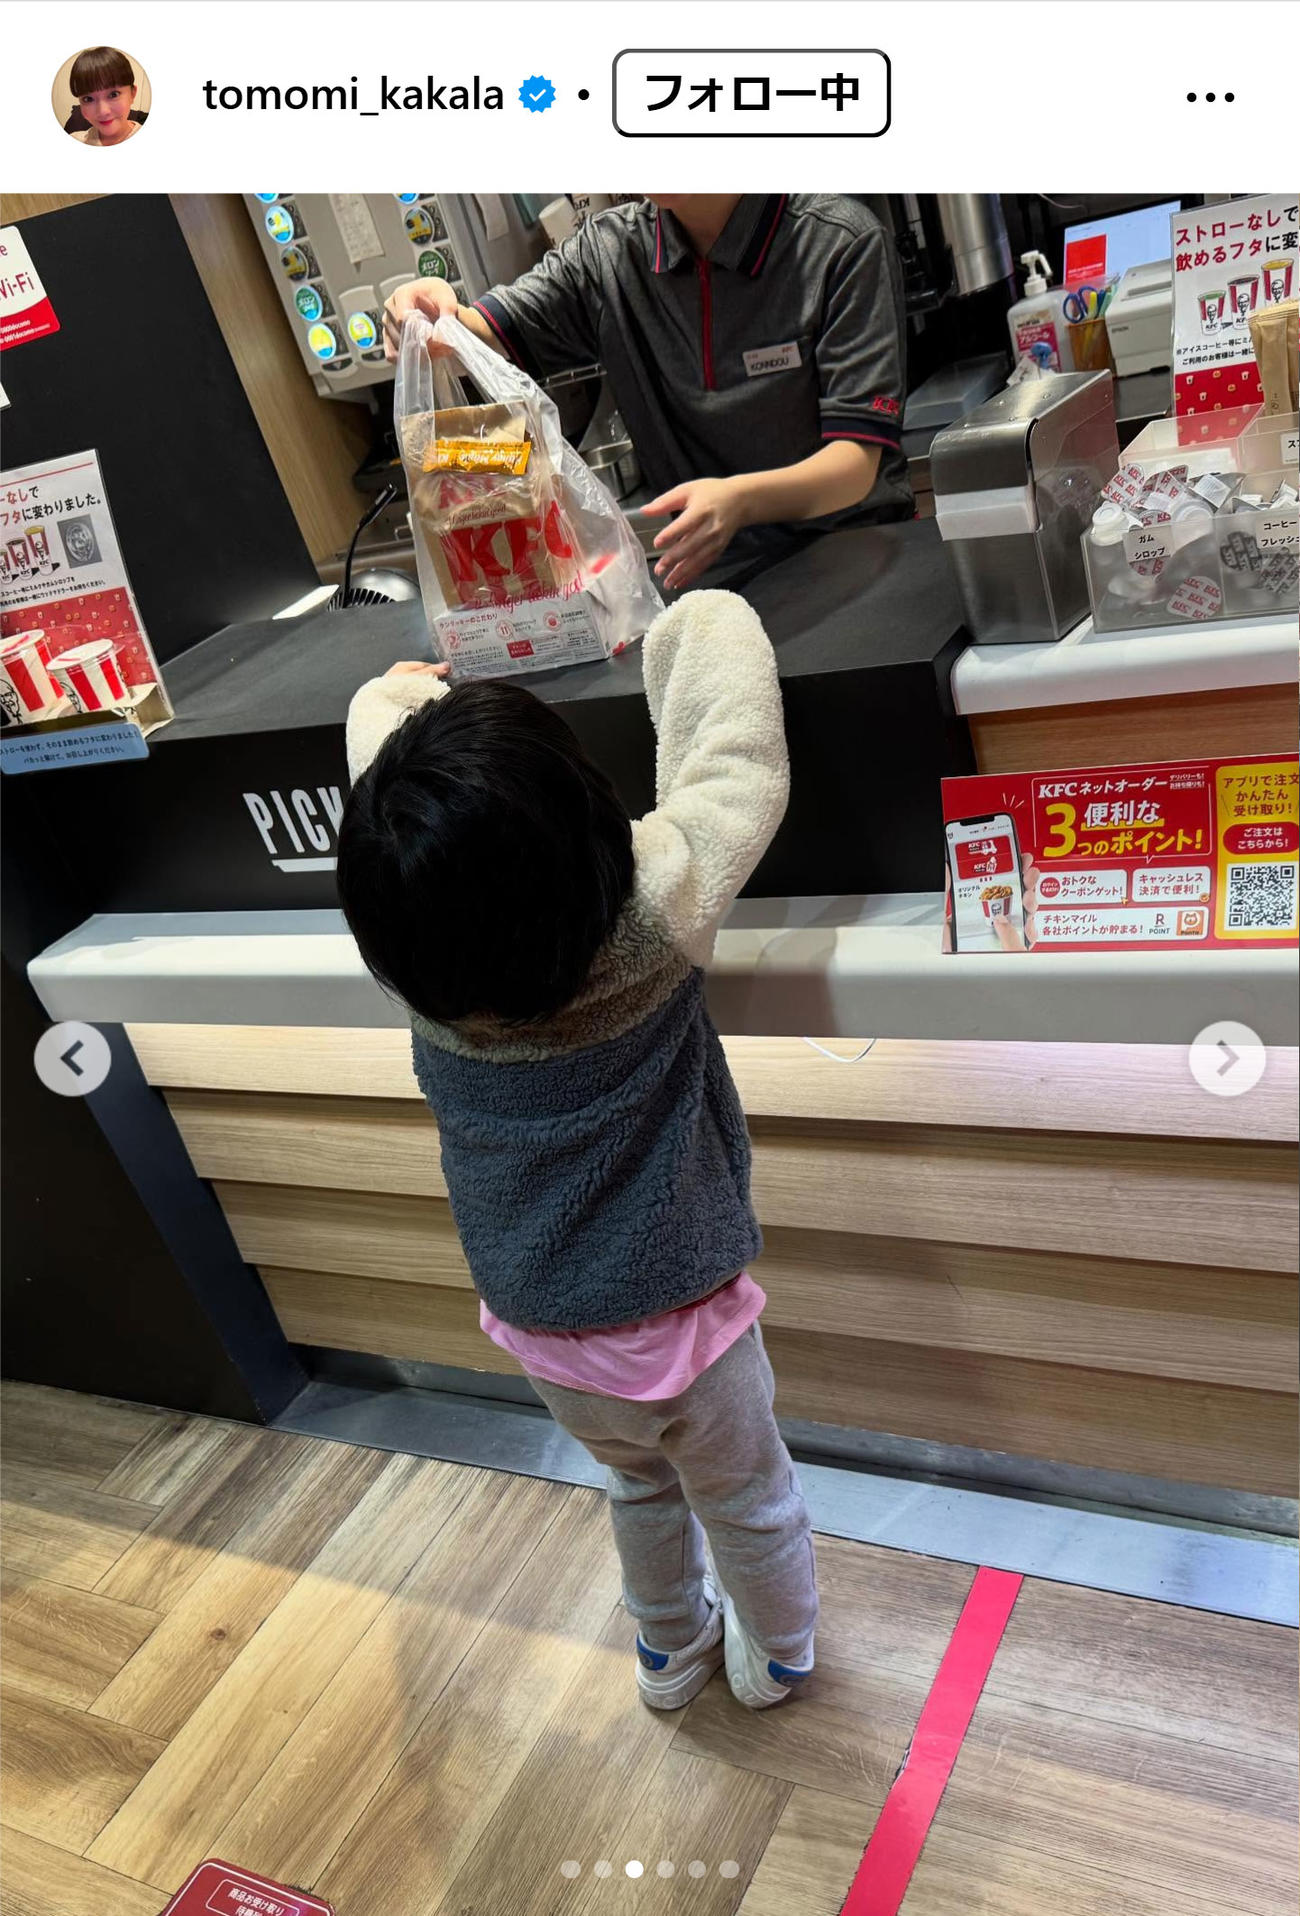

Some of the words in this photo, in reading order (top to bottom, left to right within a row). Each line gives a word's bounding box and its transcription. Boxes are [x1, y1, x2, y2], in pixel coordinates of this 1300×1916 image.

[1176, 206, 1298, 246] ストローなしで
[1176, 232, 1298, 272] 飲めるフタに変
[1288, 440, 1299, 449] ス
[1264, 521, 1297, 530] コーヒー
[1139, 535, 1154, 544] ガム
[1135, 547, 1165, 560] シロップ
[1223, 772, 1299, 789] アプリで注文
[1038, 782, 1077, 799] KFC
[1079, 777, 1168, 796] ネットオーダー
[1236, 789, 1289, 802] かんたん
[1085, 800, 1160, 827] 便利な
[1043, 802, 1076, 857] 3
[1243, 827, 1284, 838] ご注文は
[1062, 875, 1097, 885] おトクな
[1139, 873, 1204, 883] キャッシュレス
[1043, 914, 1097, 924] チキンマイル
[1156, 913, 1165, 925] R
